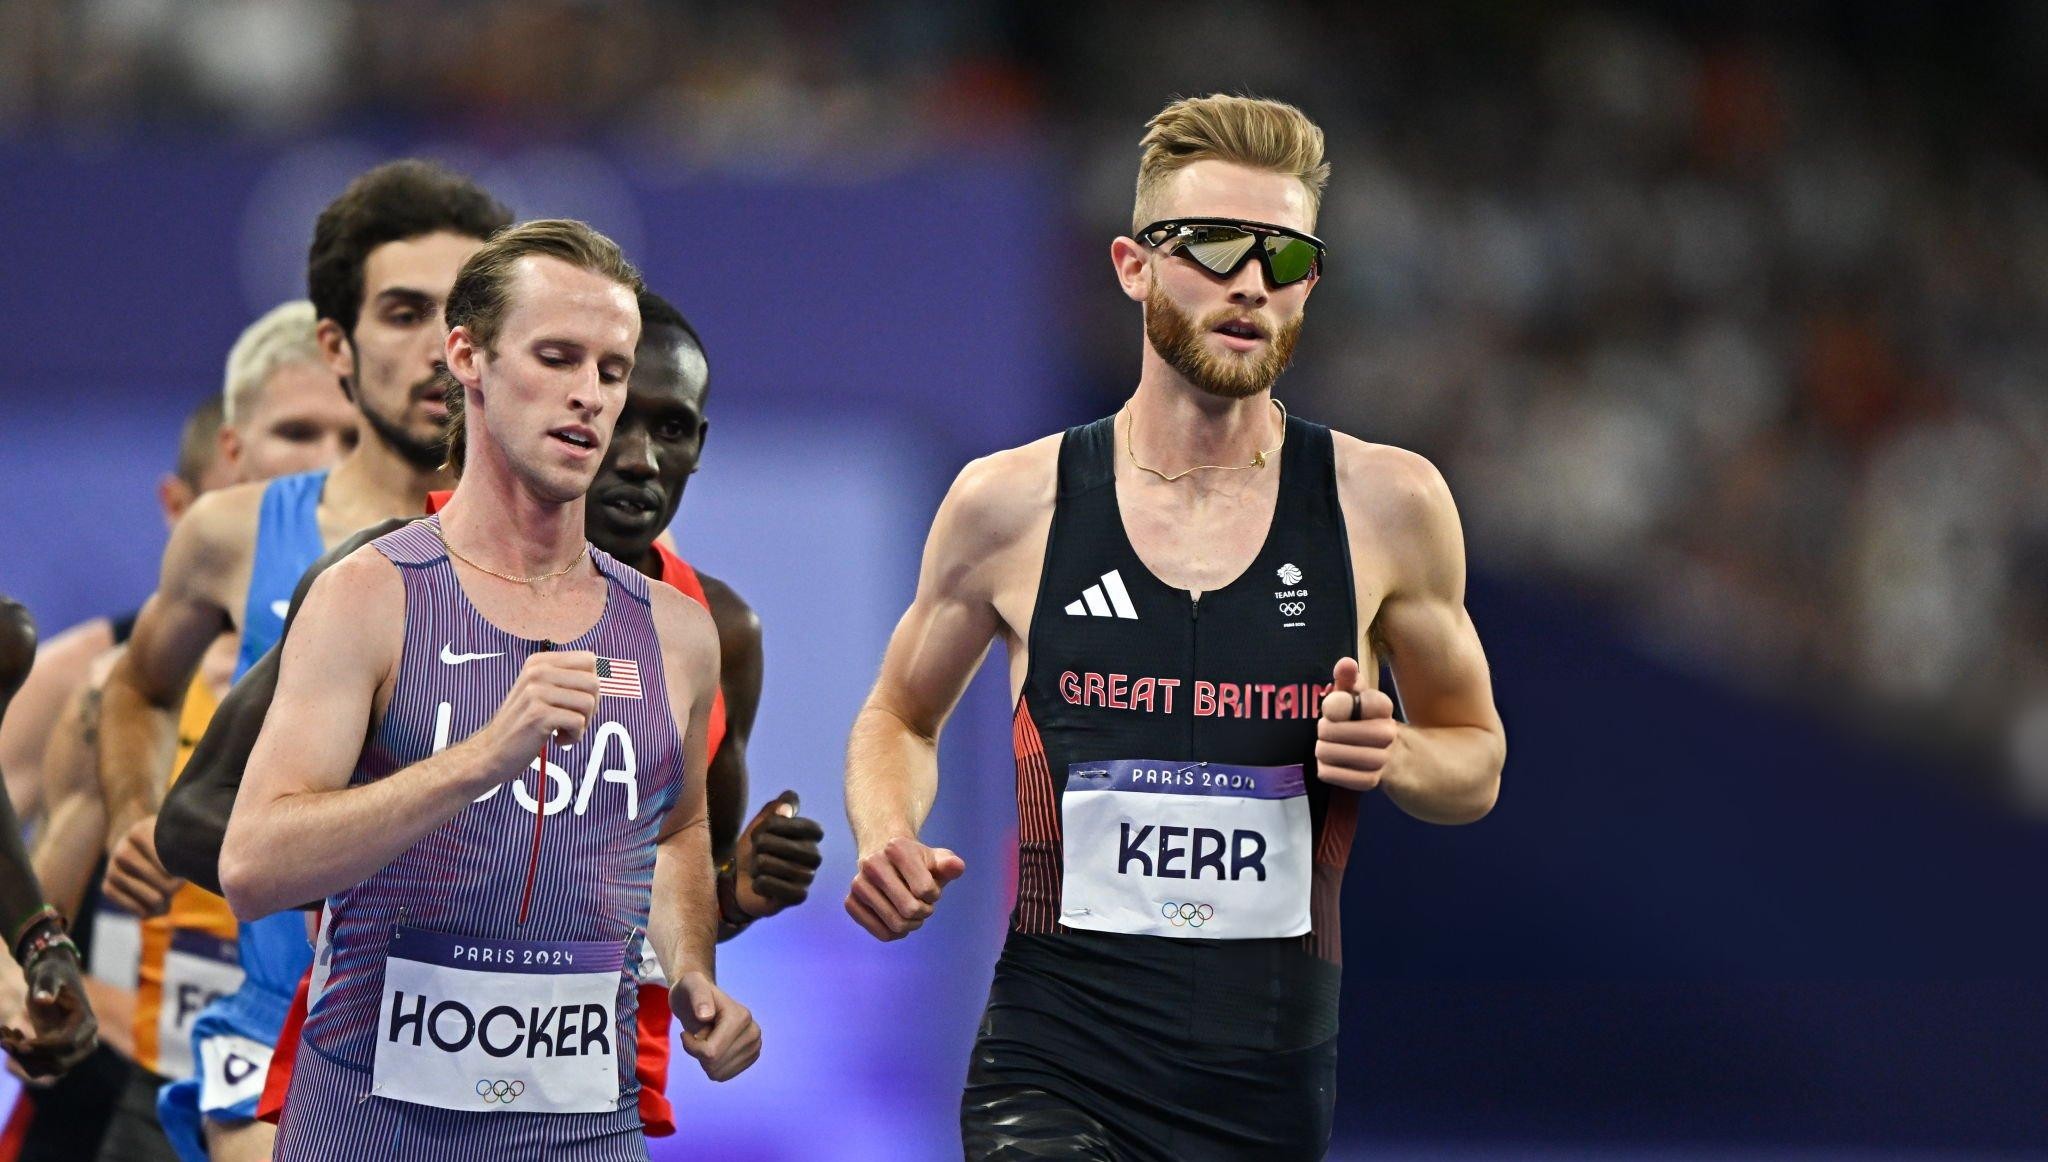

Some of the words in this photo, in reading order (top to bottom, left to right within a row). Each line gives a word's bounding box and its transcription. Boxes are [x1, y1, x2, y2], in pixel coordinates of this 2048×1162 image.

[1274, 590, 1295, 599] TEAM
[1296, 589, 1308, 597] GB
[1059, 670, 1180, 714] GREAT
[1118, 822, 1267, 882] KERR
[523, 950, 574, 966] 2024
[389, 990, 611, 1059] HOCKER
